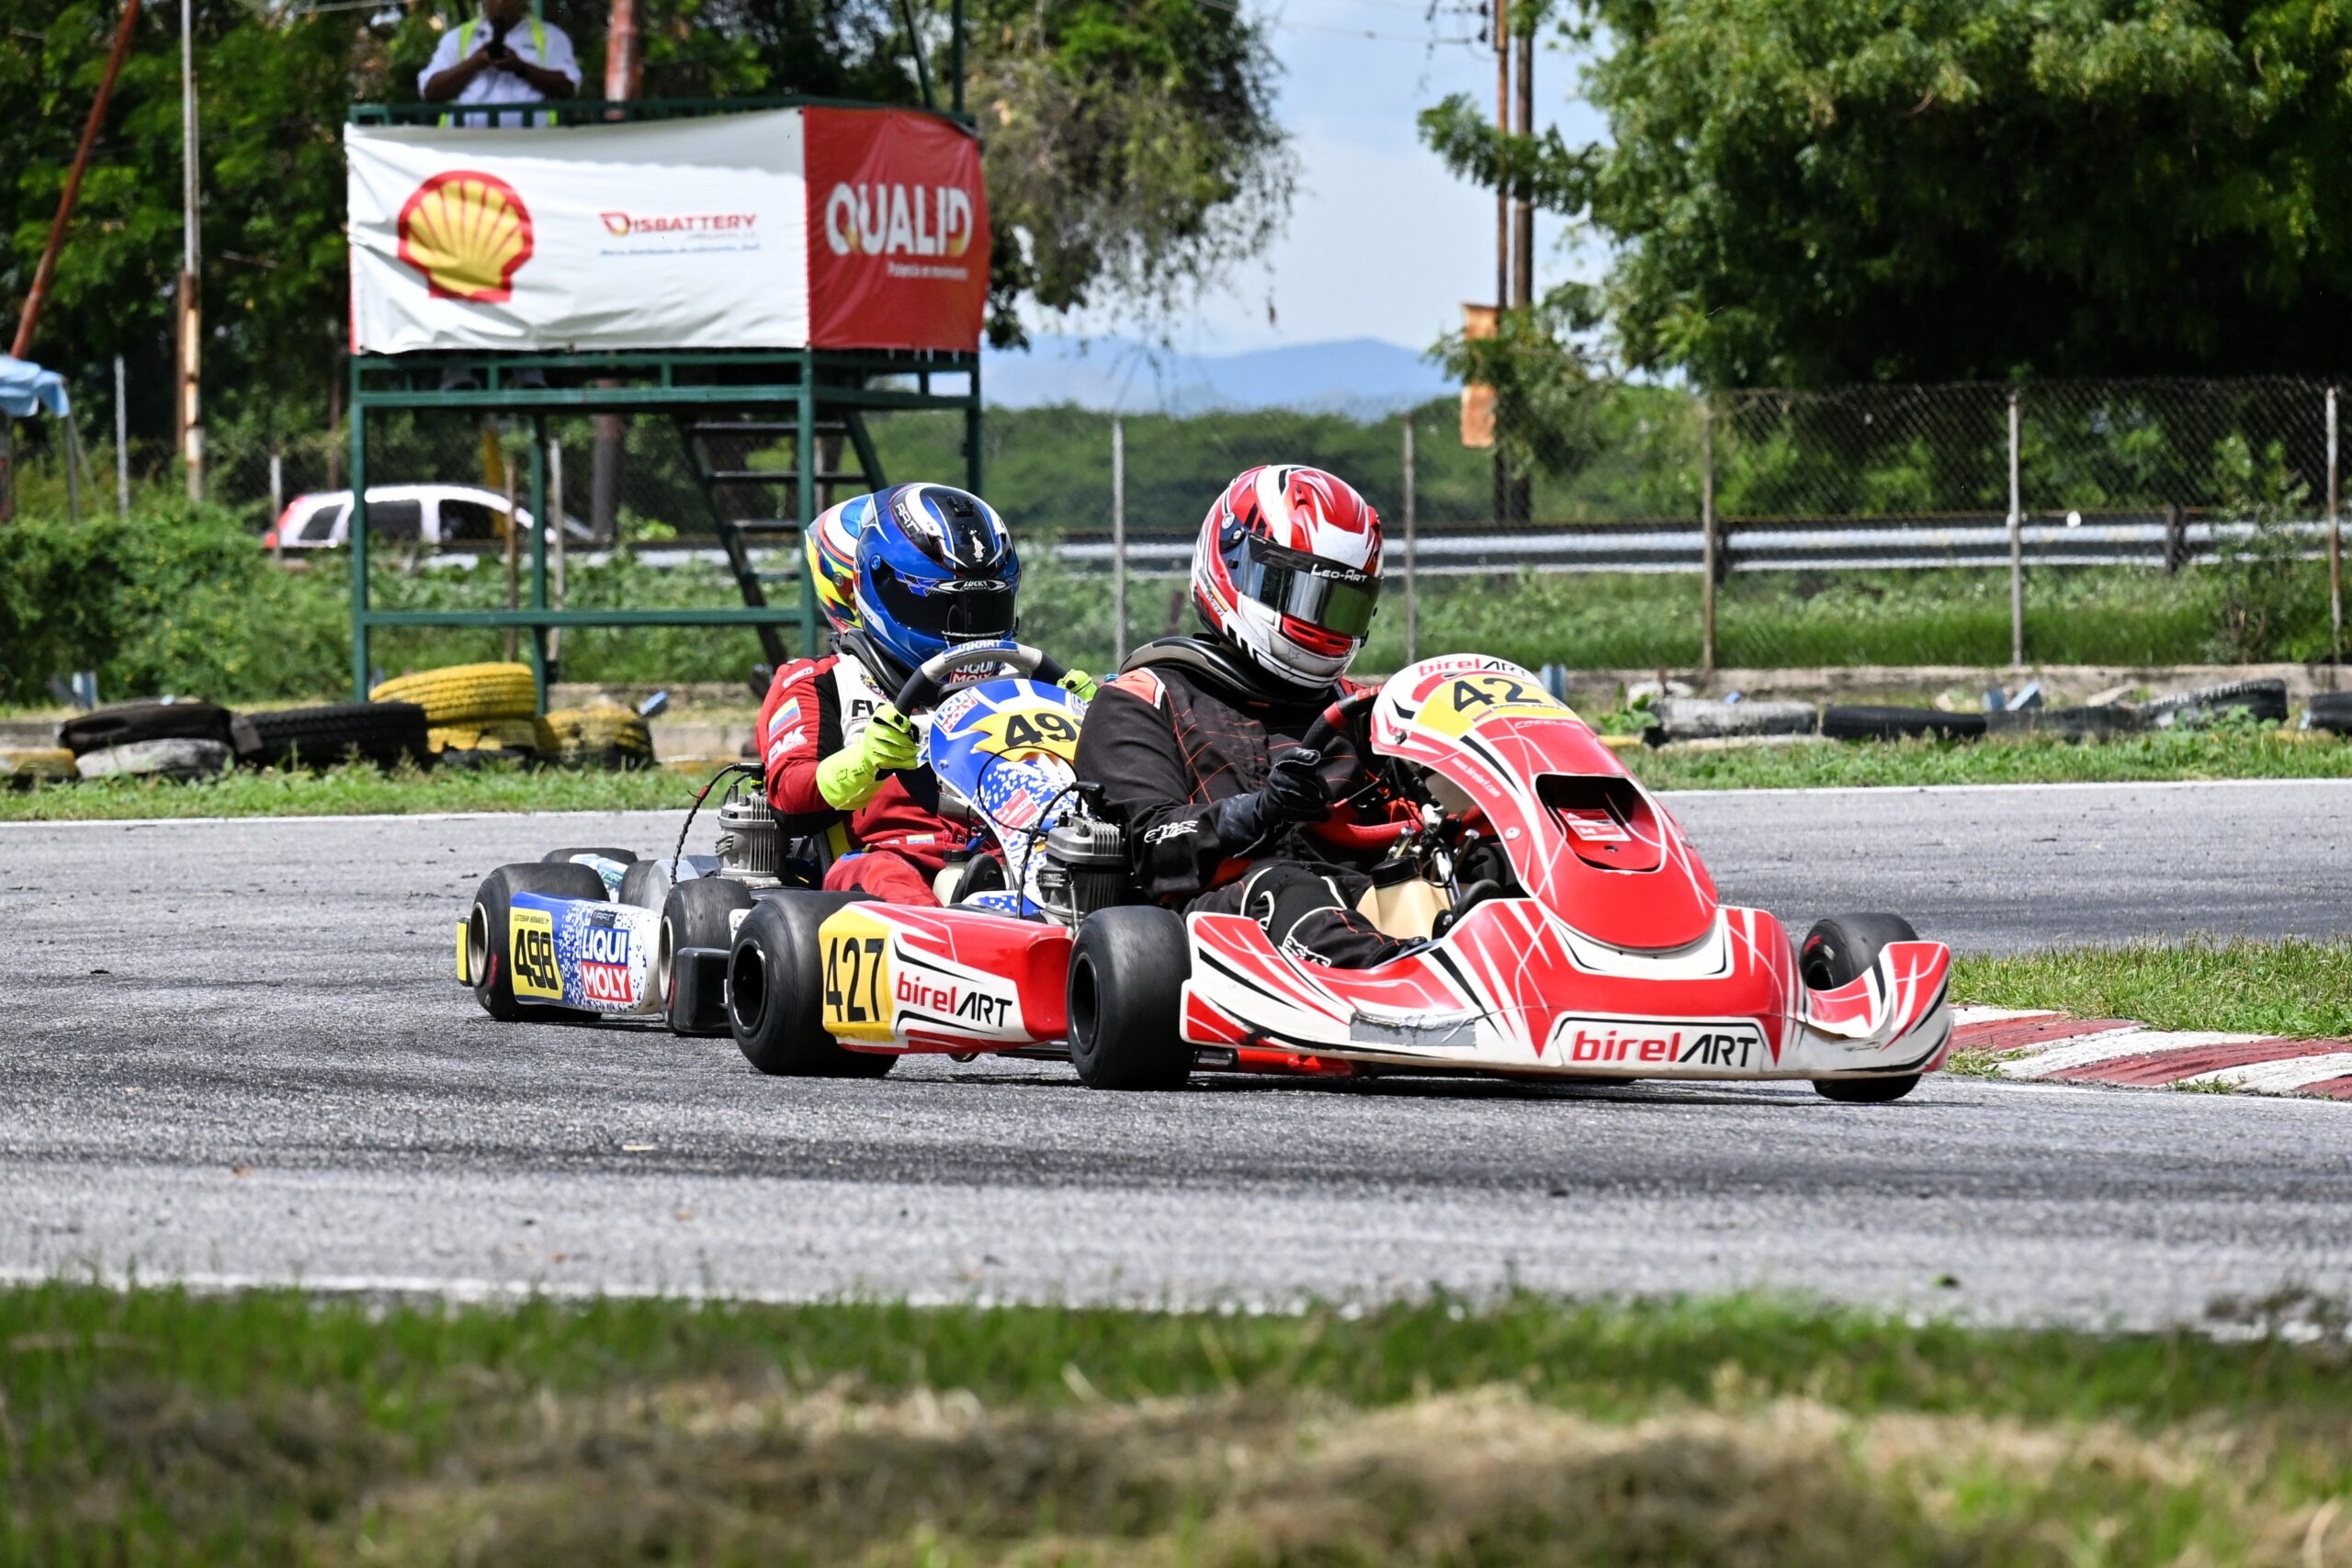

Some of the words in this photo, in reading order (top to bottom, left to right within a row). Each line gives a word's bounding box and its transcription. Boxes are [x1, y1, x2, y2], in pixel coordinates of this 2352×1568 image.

[600, 211, 756, 237] DISBATTERY
[825, 182, 973, 257] QUALID
[935, 690, 971, 727] LIQUI
[943, 698, 978, 733] MOLY
[1004, 713, 1081, 749] 49
[514, 929, 560, 991] 498
[582, 927, 628, 964] LIQUI
[582, 963, 628, 999] MOLY
[827, 936, 885, 1022] 427
[897, 972, 1013, 1028] birelART
[1572, 1030, 1758, 1068] birelART
